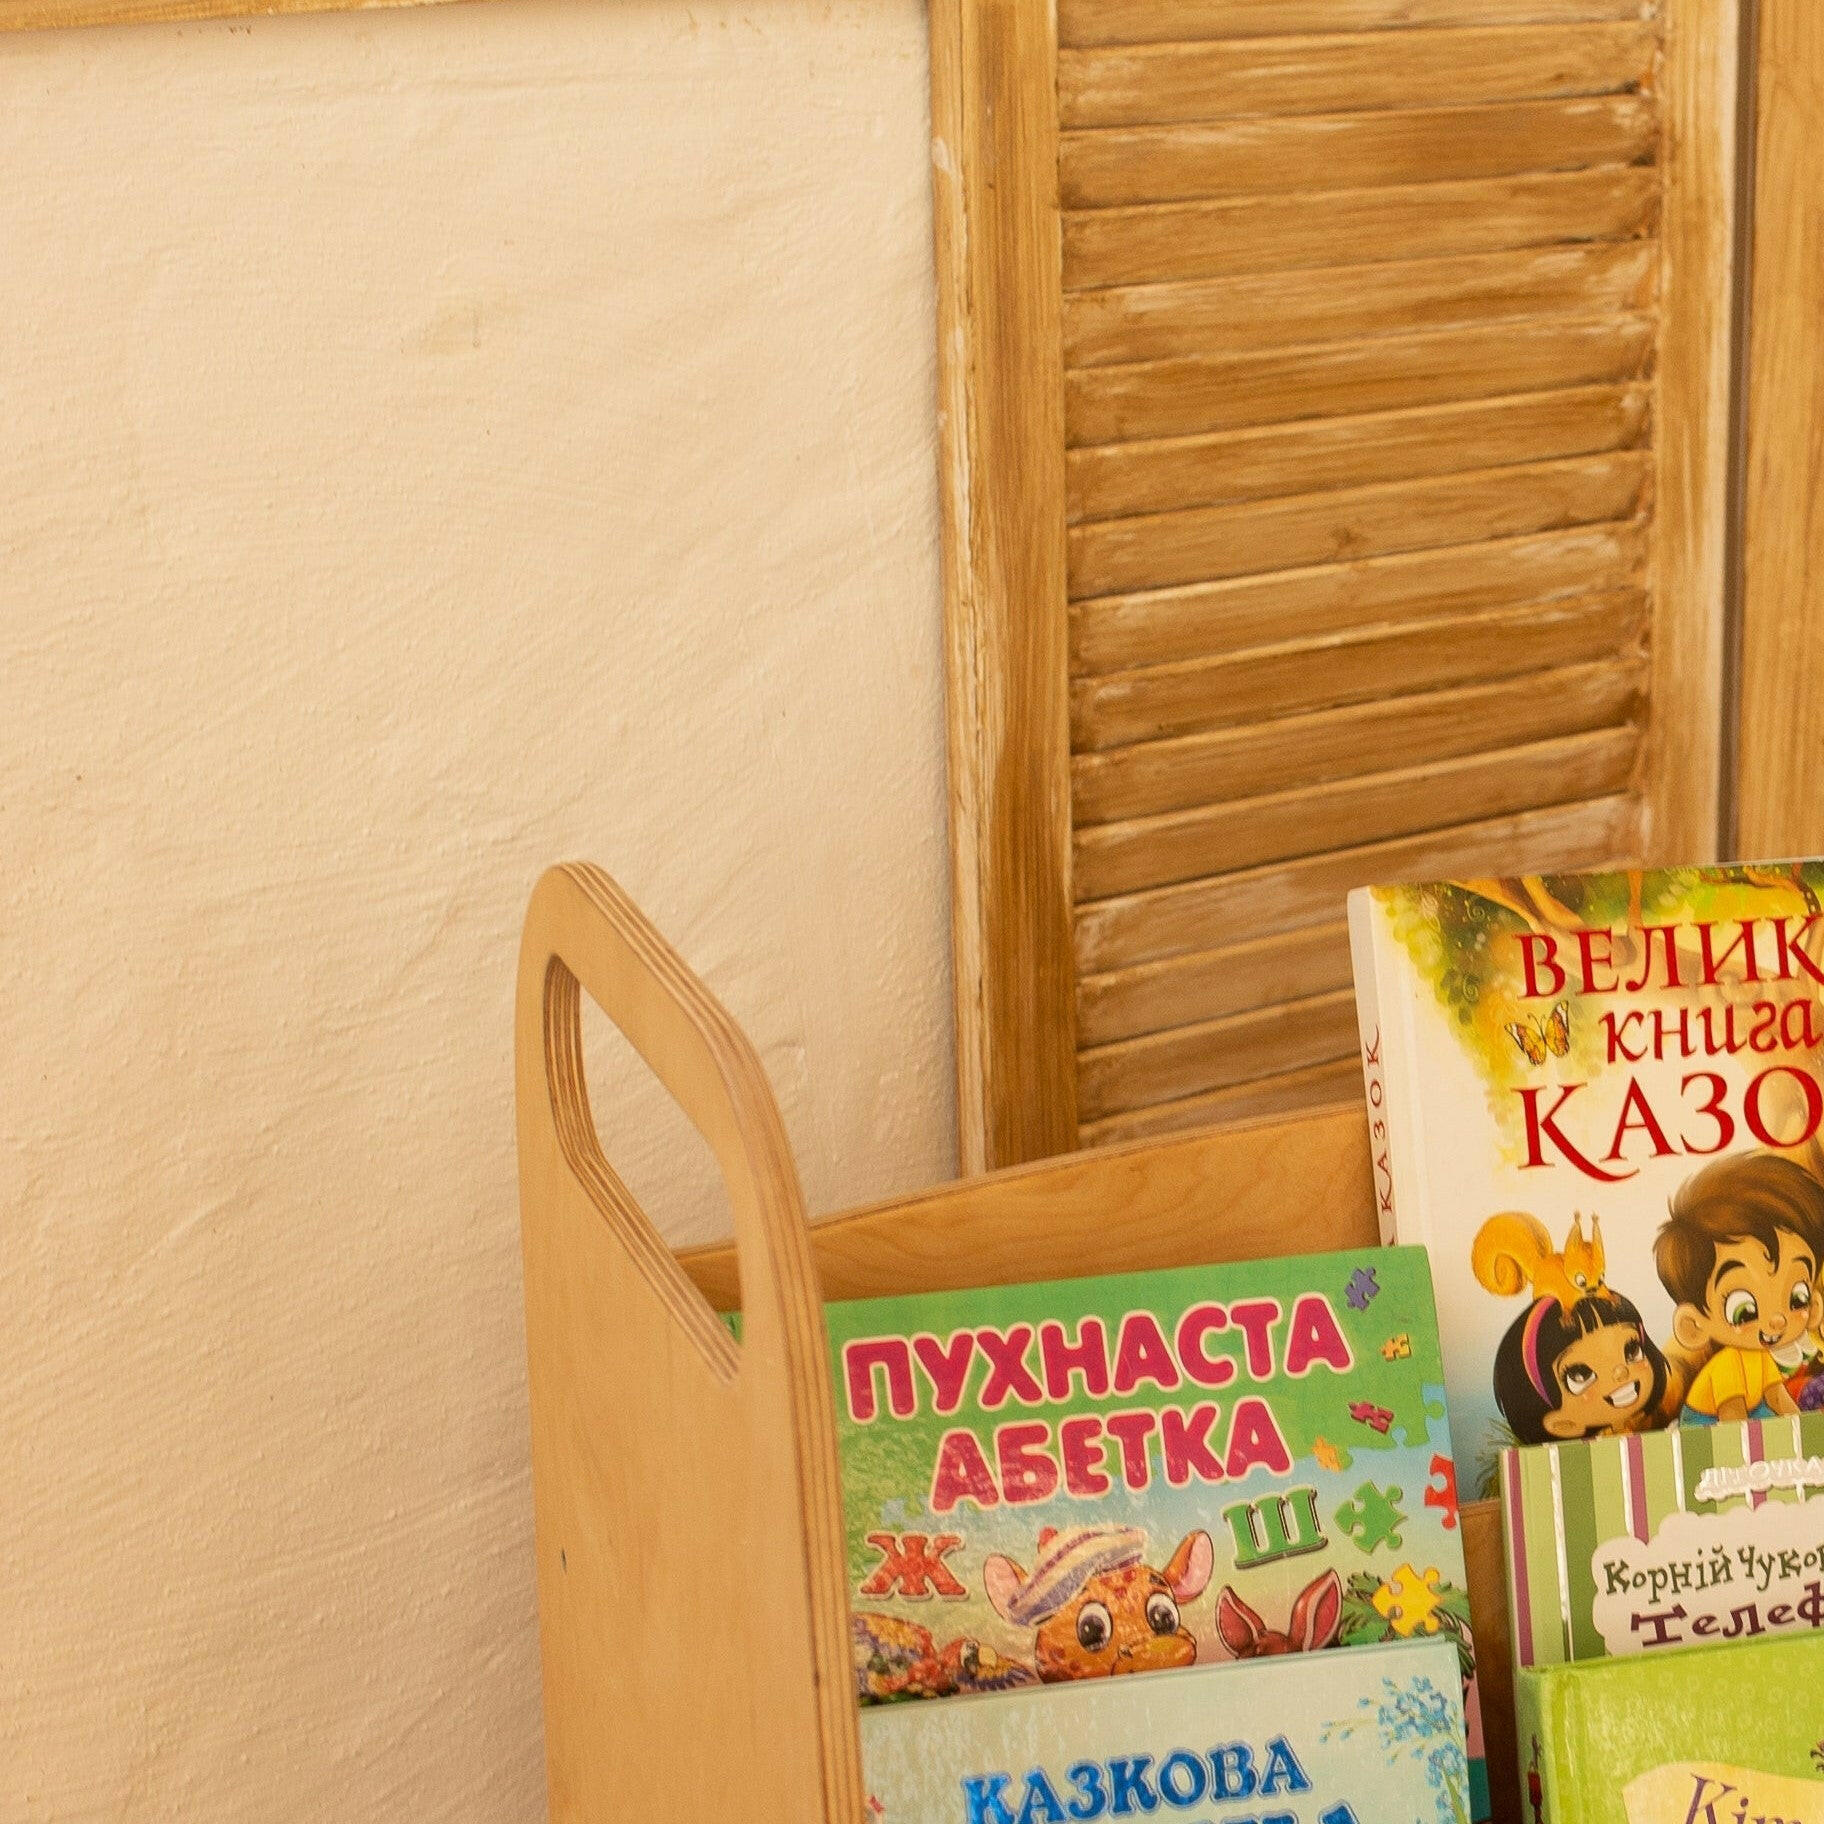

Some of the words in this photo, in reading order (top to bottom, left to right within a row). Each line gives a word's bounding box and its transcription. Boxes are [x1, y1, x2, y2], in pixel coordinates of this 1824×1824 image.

[1600, 999, 1824, 1065] книга
[1365, 1023, 1393, 1214] КАЗОК
[843, 1292, 1355, 1424] ПУХНАСТА
[930, 1396, 1294, 1515] АБЕТКА
[858, 1532, 968, 1600] Ж
[1603, 1543, 1734, 1604] Корній
